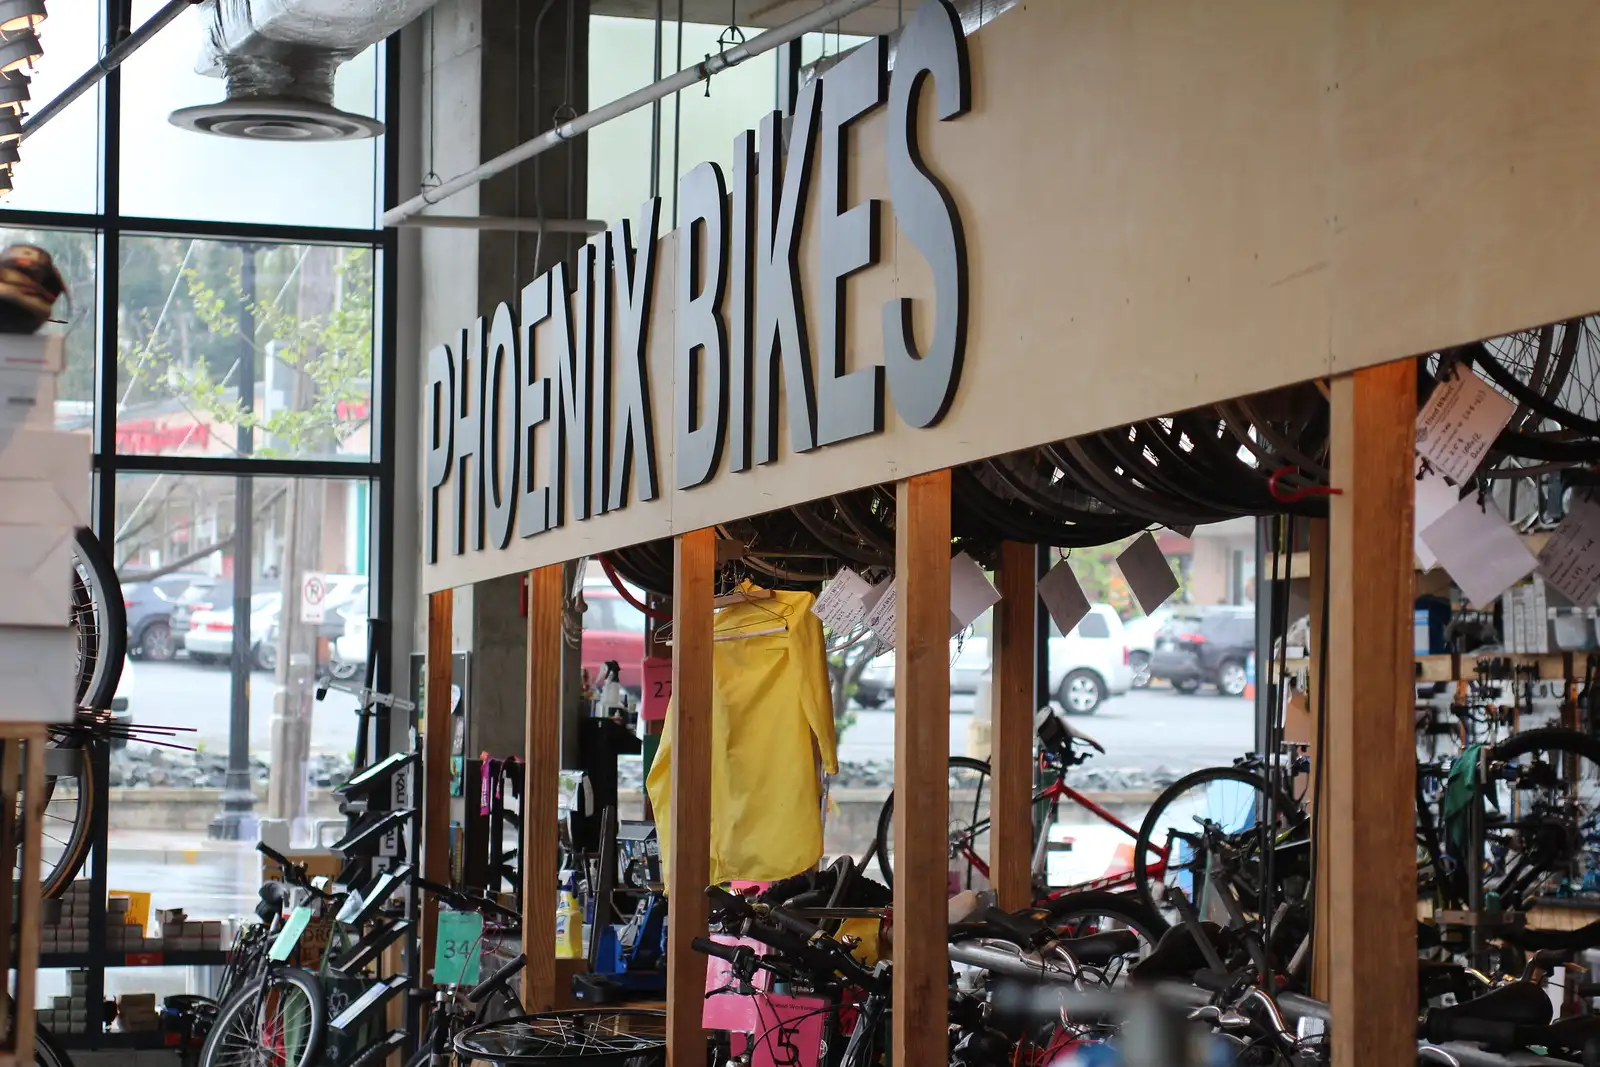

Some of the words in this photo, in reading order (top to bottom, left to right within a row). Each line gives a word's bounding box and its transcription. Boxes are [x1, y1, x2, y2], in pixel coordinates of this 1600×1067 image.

[426, 196, 661, 565] PHOENIX
[678, 0, 971, 490] BIKES
[395, 774, 405, 803] KALI
[444, 939, 470, 959] 34
[775, 1027, 799, 1066] 5
